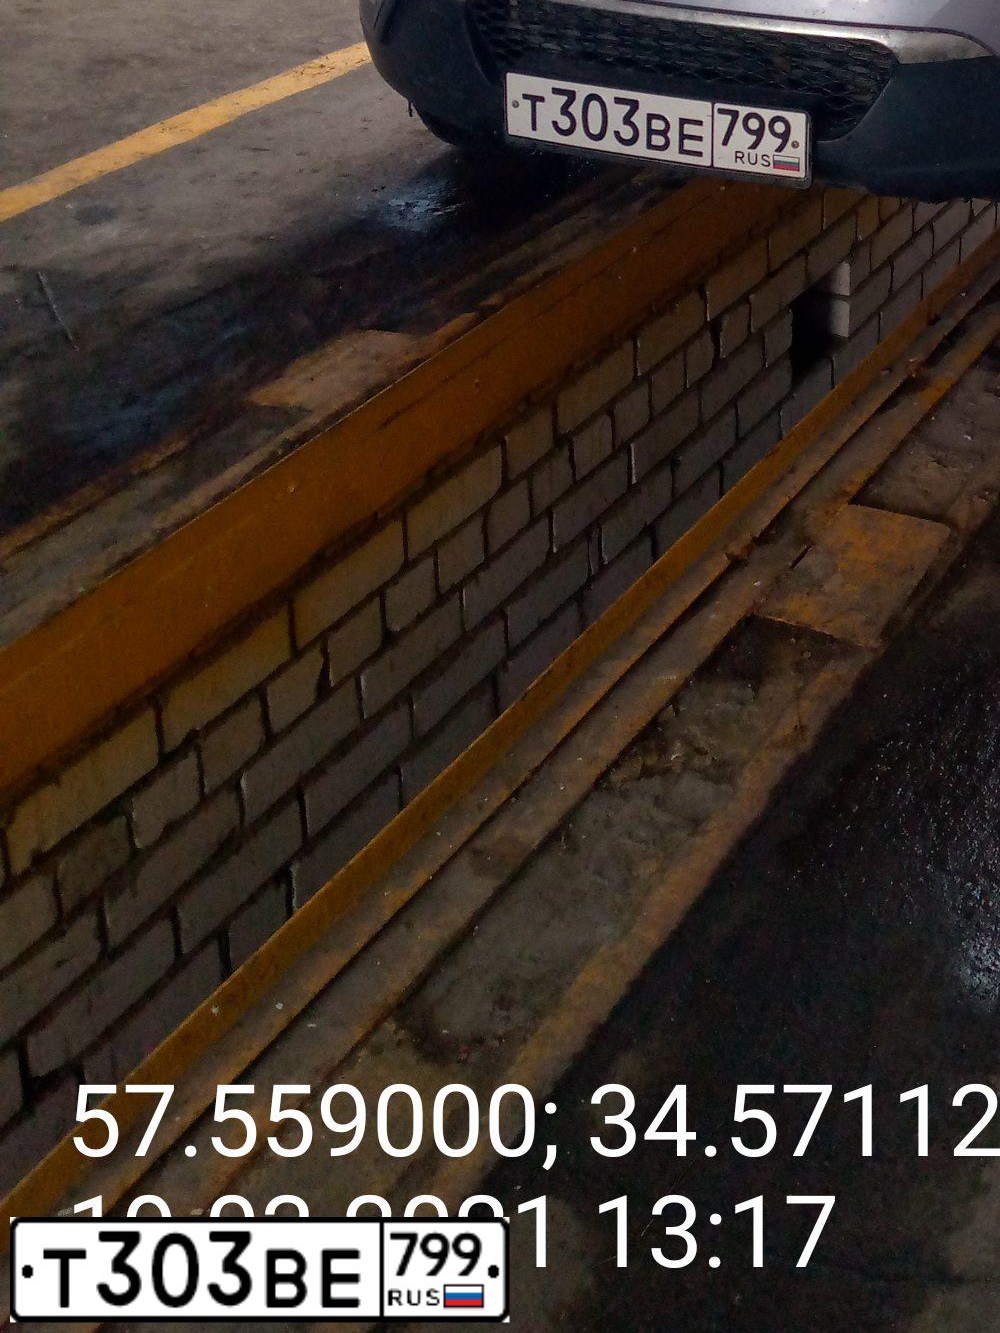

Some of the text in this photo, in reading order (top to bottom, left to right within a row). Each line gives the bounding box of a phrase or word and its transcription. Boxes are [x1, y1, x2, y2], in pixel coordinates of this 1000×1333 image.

[521, 87, 704, 157] Т303ВЕ
[717, 108, 792, 153] 799
[735, 150, 772, 168] RUS
